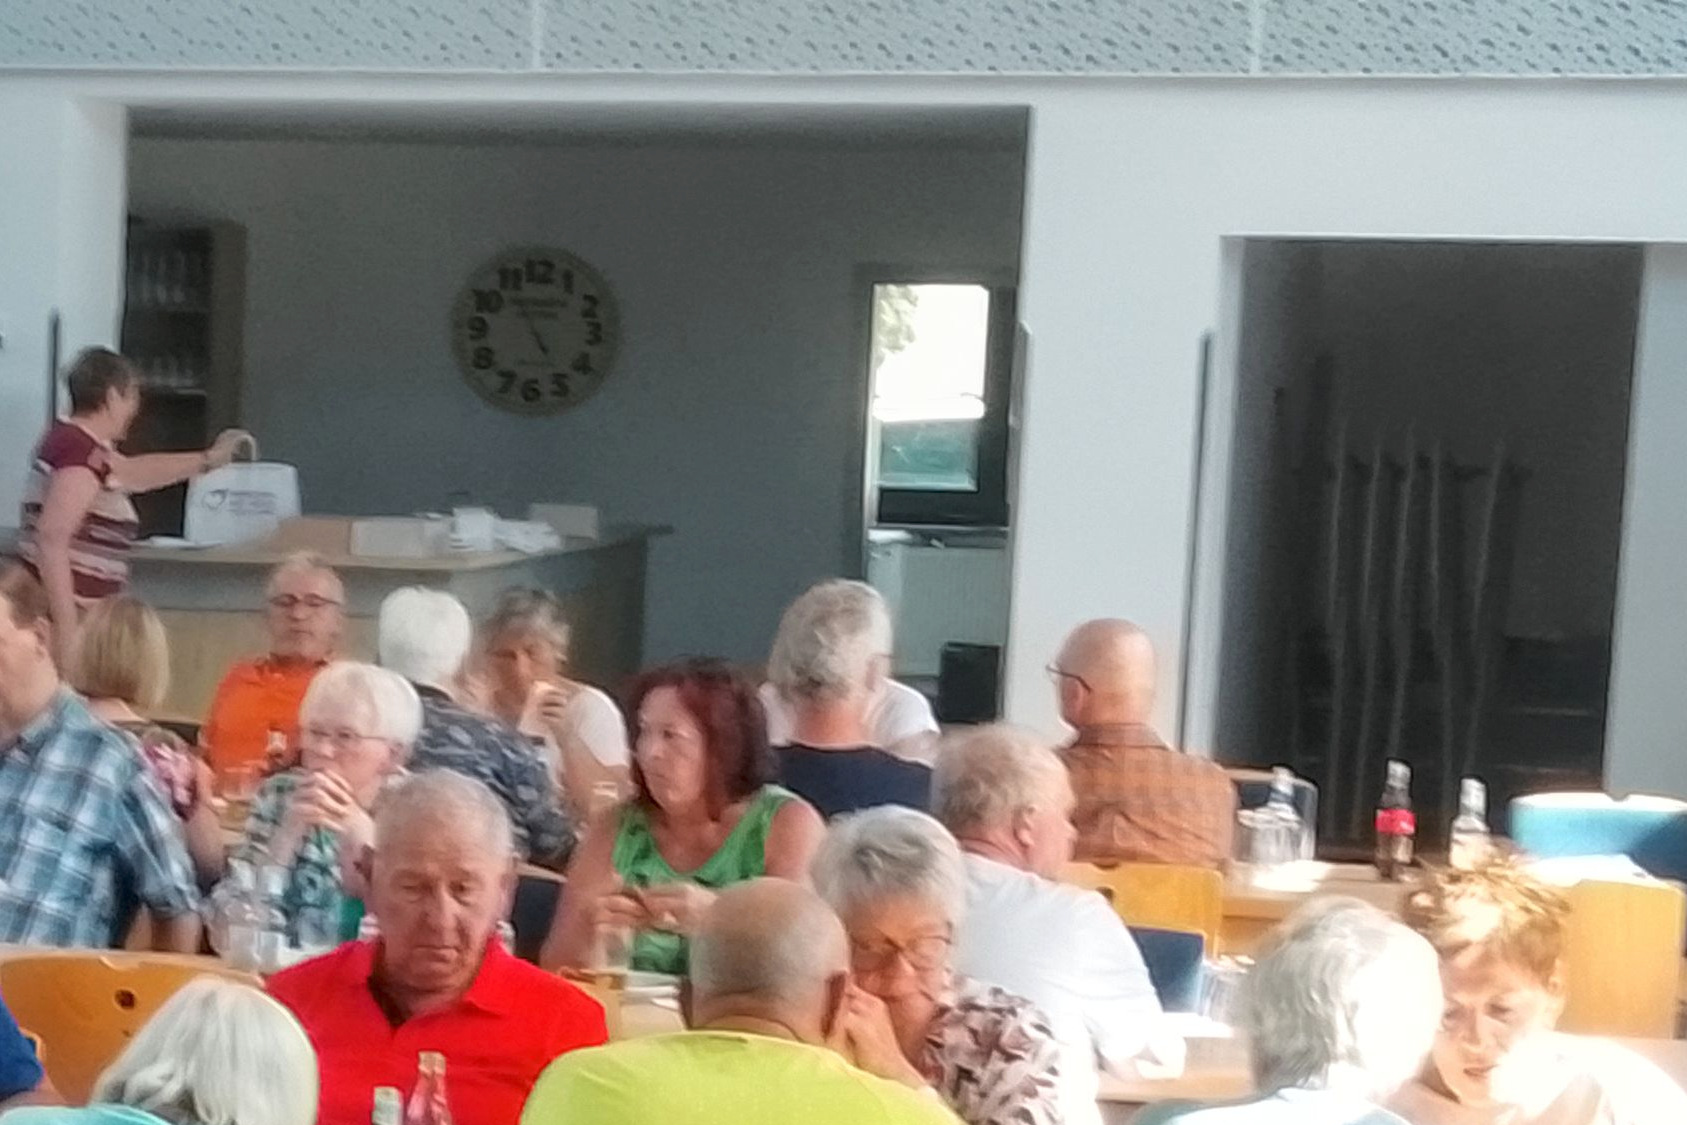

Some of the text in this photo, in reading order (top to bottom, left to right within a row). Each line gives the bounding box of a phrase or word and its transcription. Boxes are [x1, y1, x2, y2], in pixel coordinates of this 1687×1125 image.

[498, 268, 522, 291] 11
[526, 260, 555, 284] 12
[563, 269, 573, 294] 1
[472, 289, 503, 313] 10
[582, 294, 598, 318] 2
[468, 316, 488, 340] 9
[585, 321, 602, 346] 3
[473, 346, 494, 369] 8
[572, 352, 594, 375] 4
[497, 370, 517, 393] 7
[521, 378, 540, 402] 6
[550, 373, 569, 397] 5
